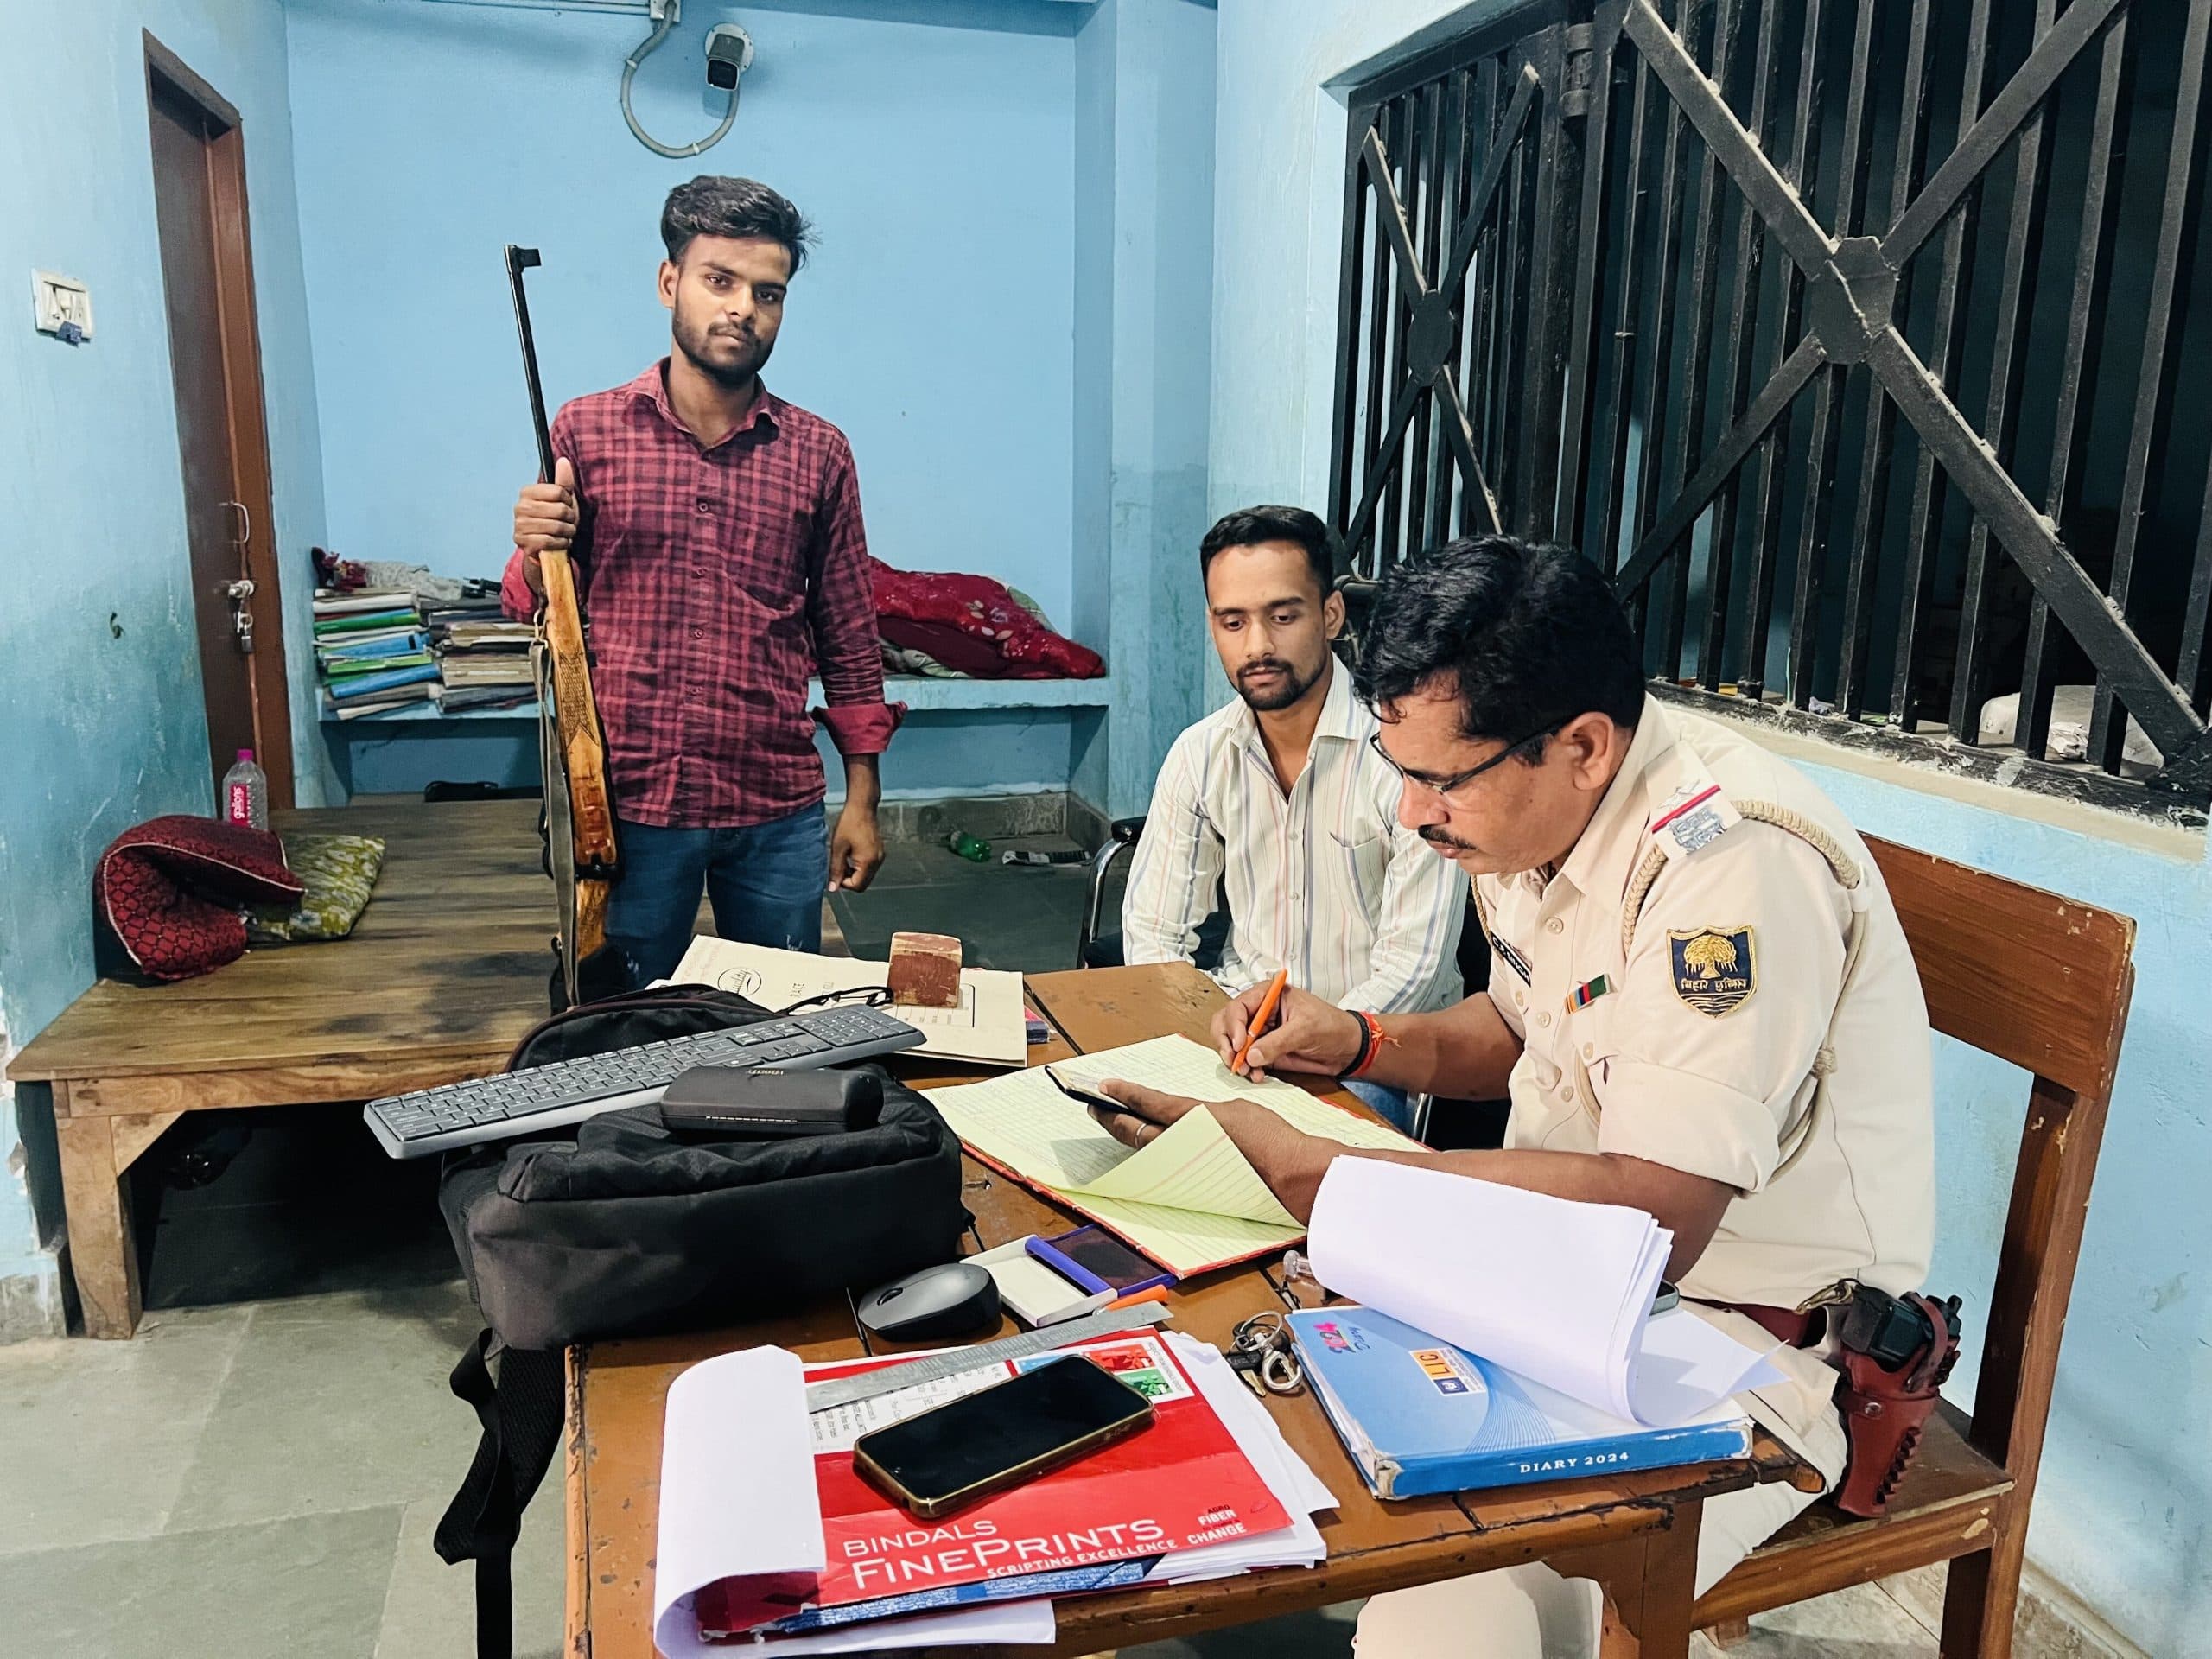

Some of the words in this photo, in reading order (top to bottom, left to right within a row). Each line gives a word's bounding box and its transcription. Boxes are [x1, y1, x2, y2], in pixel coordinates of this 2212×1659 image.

[1681, 977, 1709, 992] बिहार
[1714, 976, 1747, 992] पुलिस
[1419, 1354, 1451, 1376] LIC
[1520, 1458, 1579, 1473] DIARY
[1584, 1452, 1630, 1465] 2024
[1197, 1509, 1237, 1526] FIBER
[1207, 1504, 1230, 1514] AGRO
[842, 1519, 998, 1558] BINDALS
[1186, 1522, 1247, 1545] CHANGE
[985, 1554, 1073, 1580] SCRIPTING
[1077, 1539, 1179, 1565] EXCELLENCE
